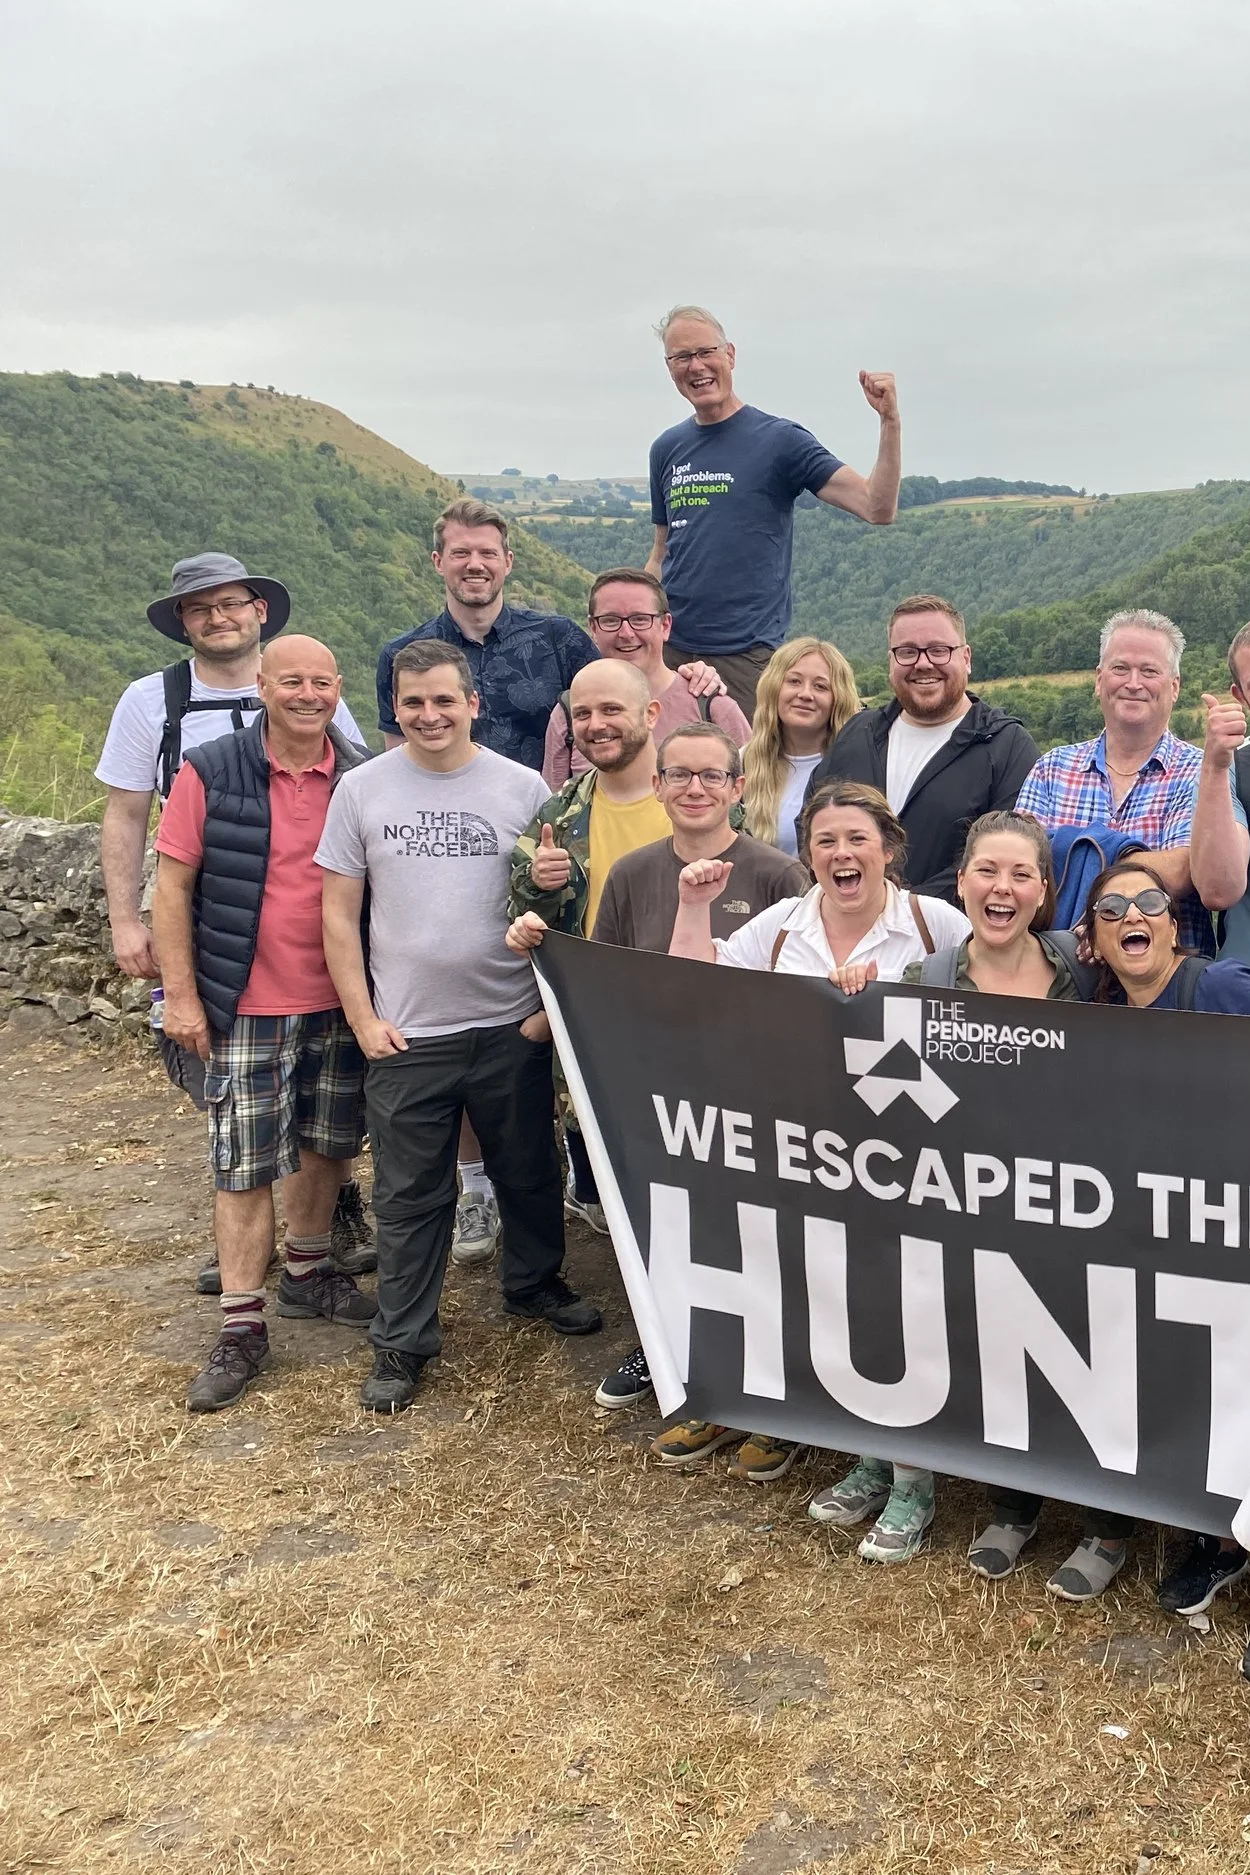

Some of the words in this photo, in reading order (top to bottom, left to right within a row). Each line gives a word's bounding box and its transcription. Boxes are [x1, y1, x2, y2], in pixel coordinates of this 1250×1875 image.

[676, 462, 691, 475] got
[671, 474, 682, 486] 99
[682, 471, 735, 484] problems,
[670, 485, 682, 497] but
[683, 486, 690, 494] a
[691, 482, 728, 494] breach
[670, 496, 686, 509] ain't
[687, 496, 710, 506] one.
[416, 810, 458, 827] THE
[384, 825, 460, 842] NORTH
[405, 841, 459, 857] FACE
[926, 999, 966, 1022] THE
[926, 1020, 1066, 1050] PENDRAGON
[926, 1040, 1025, 1066] PROJECT
[652, 1094, 756, 1173] WE
[774, 1119, 1115, 1230] ESCAPED
